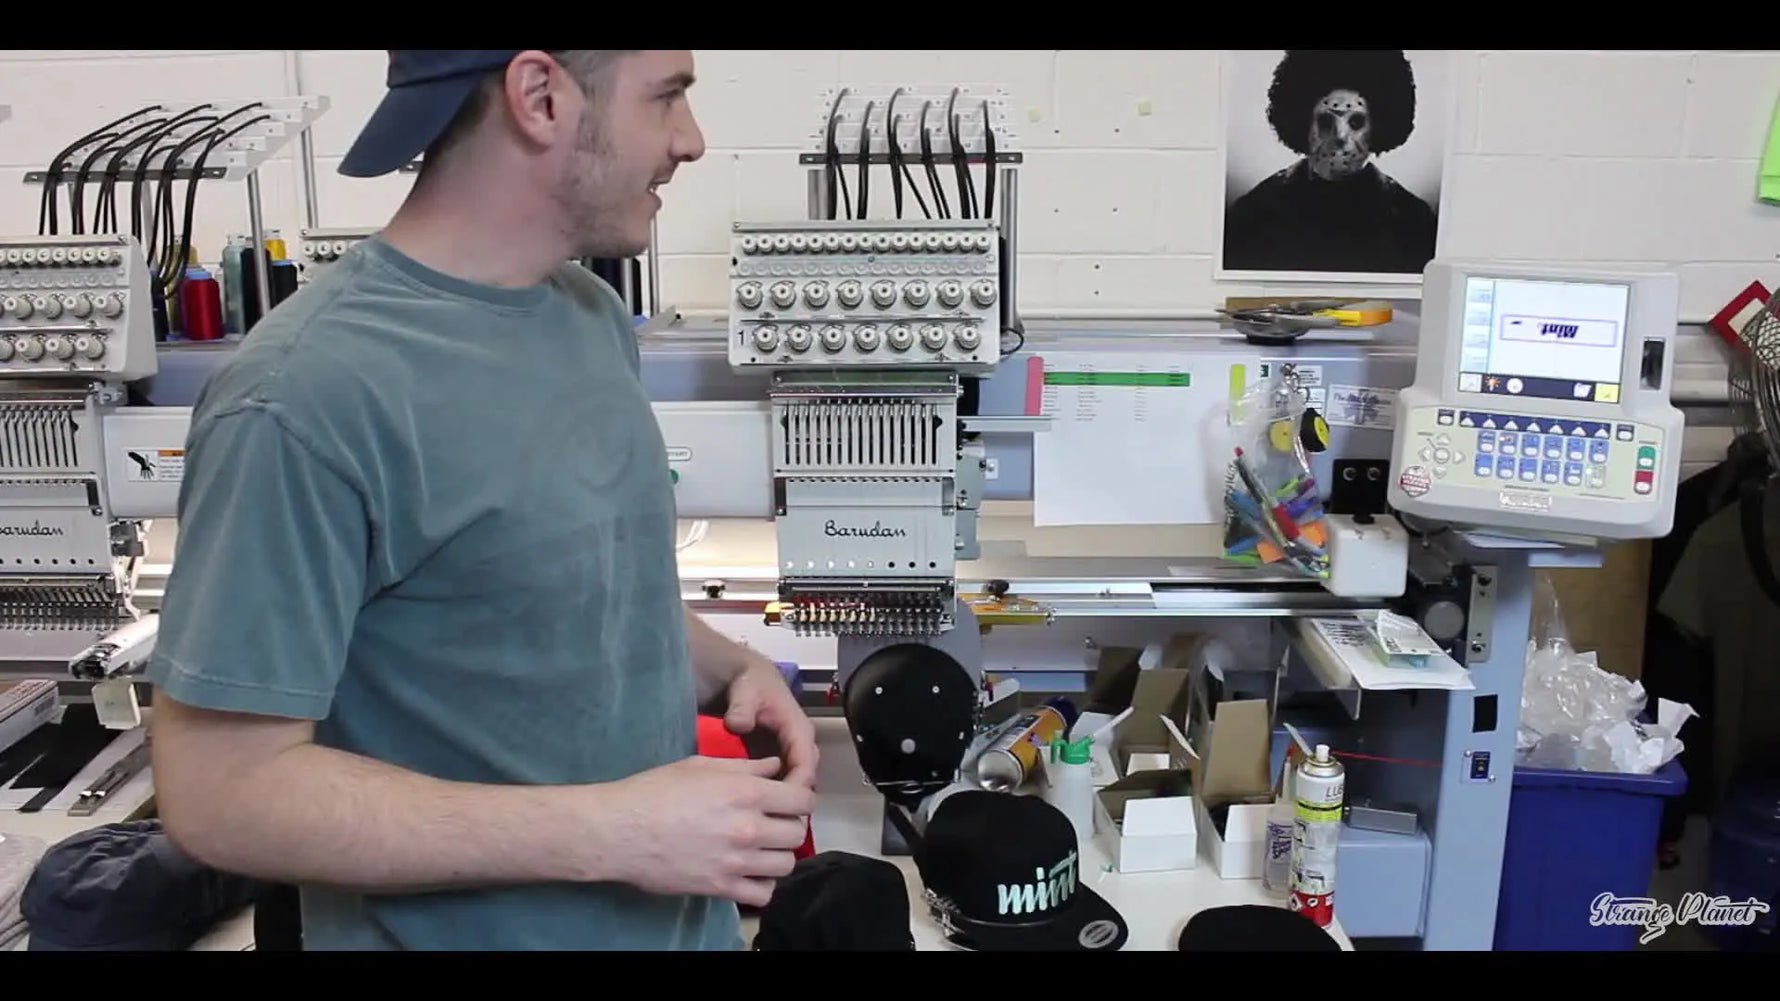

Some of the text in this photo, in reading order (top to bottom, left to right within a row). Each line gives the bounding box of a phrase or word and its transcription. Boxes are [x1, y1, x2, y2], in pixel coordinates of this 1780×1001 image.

[738, 330, 744, 346] 1
[0, 520, 64, 536] arudan
[824, 519, 906, 537] Barudan
[997, 849, 1077, 915] mint
